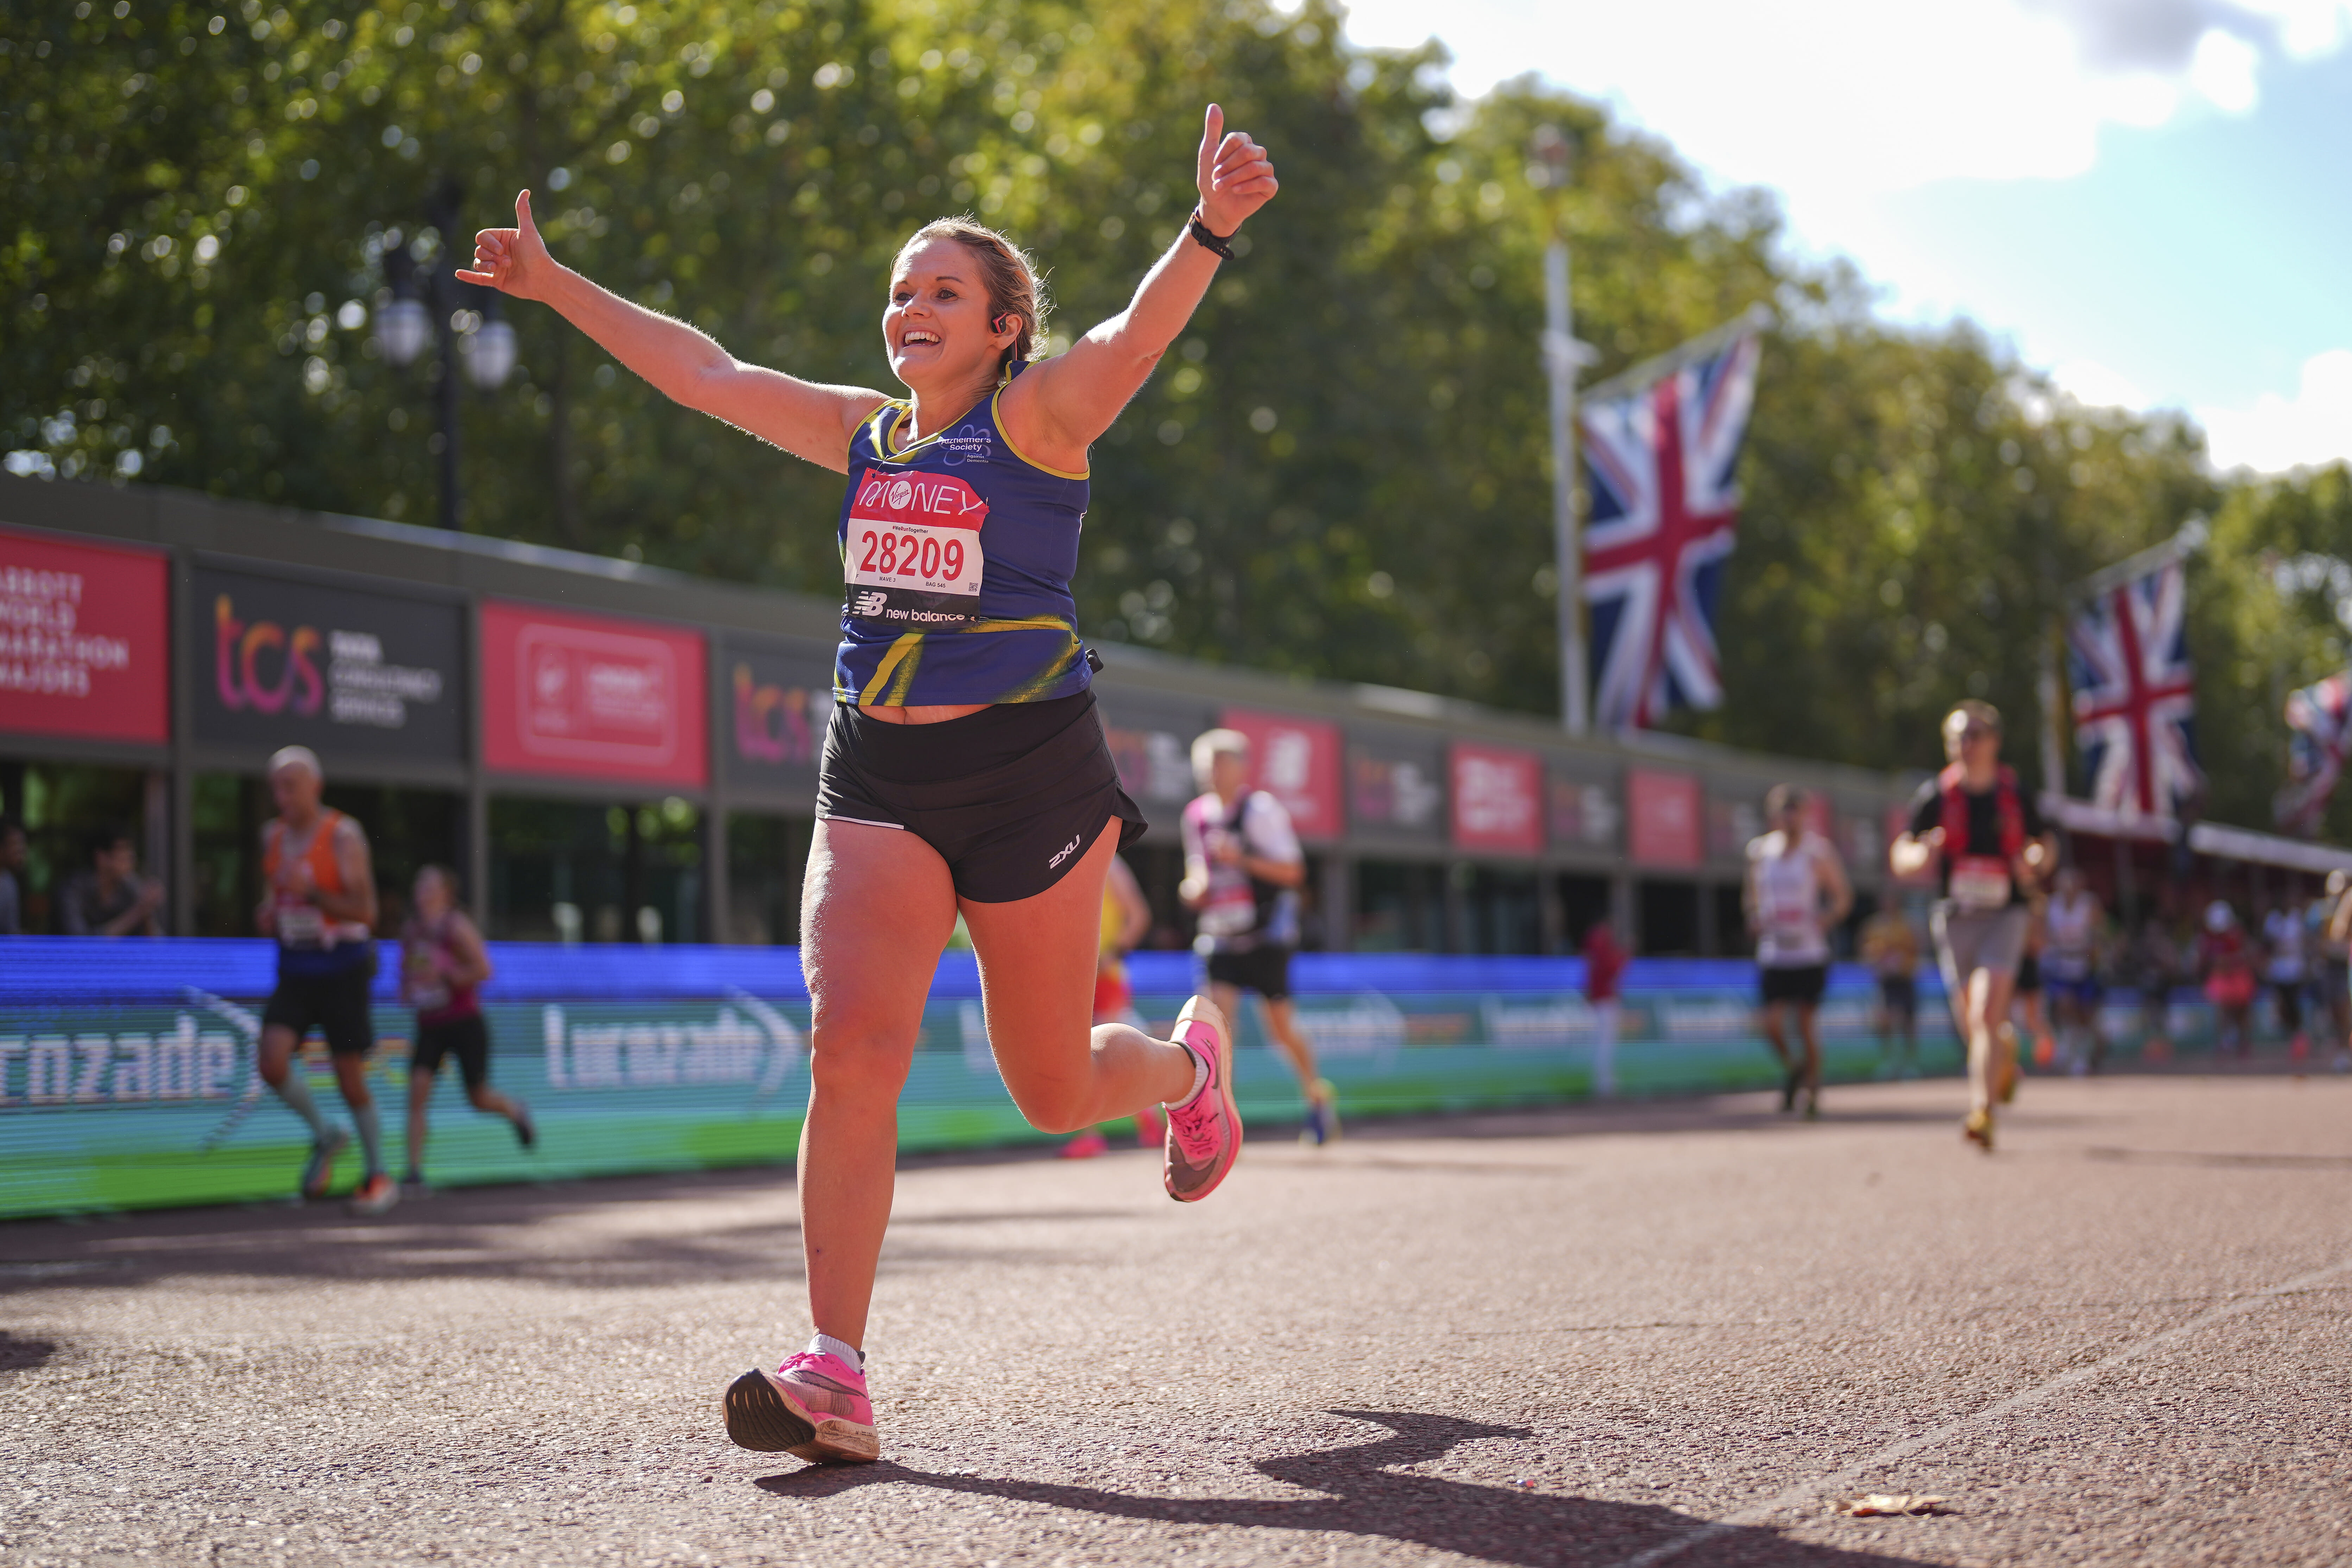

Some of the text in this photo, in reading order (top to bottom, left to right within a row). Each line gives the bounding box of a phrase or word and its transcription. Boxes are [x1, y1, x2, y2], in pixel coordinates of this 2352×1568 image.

[950, 443, 982, 452] Society
[890, 484, 910, 505] Virgin
[892, 525, 929, 534] #WeRunTogether
[860, 530, 964, 581] 28209
[886, 608, 966, 622] new balance
[215, 593, 323, 716] tcs
[1049, 834, 1081, 870] 2XU
